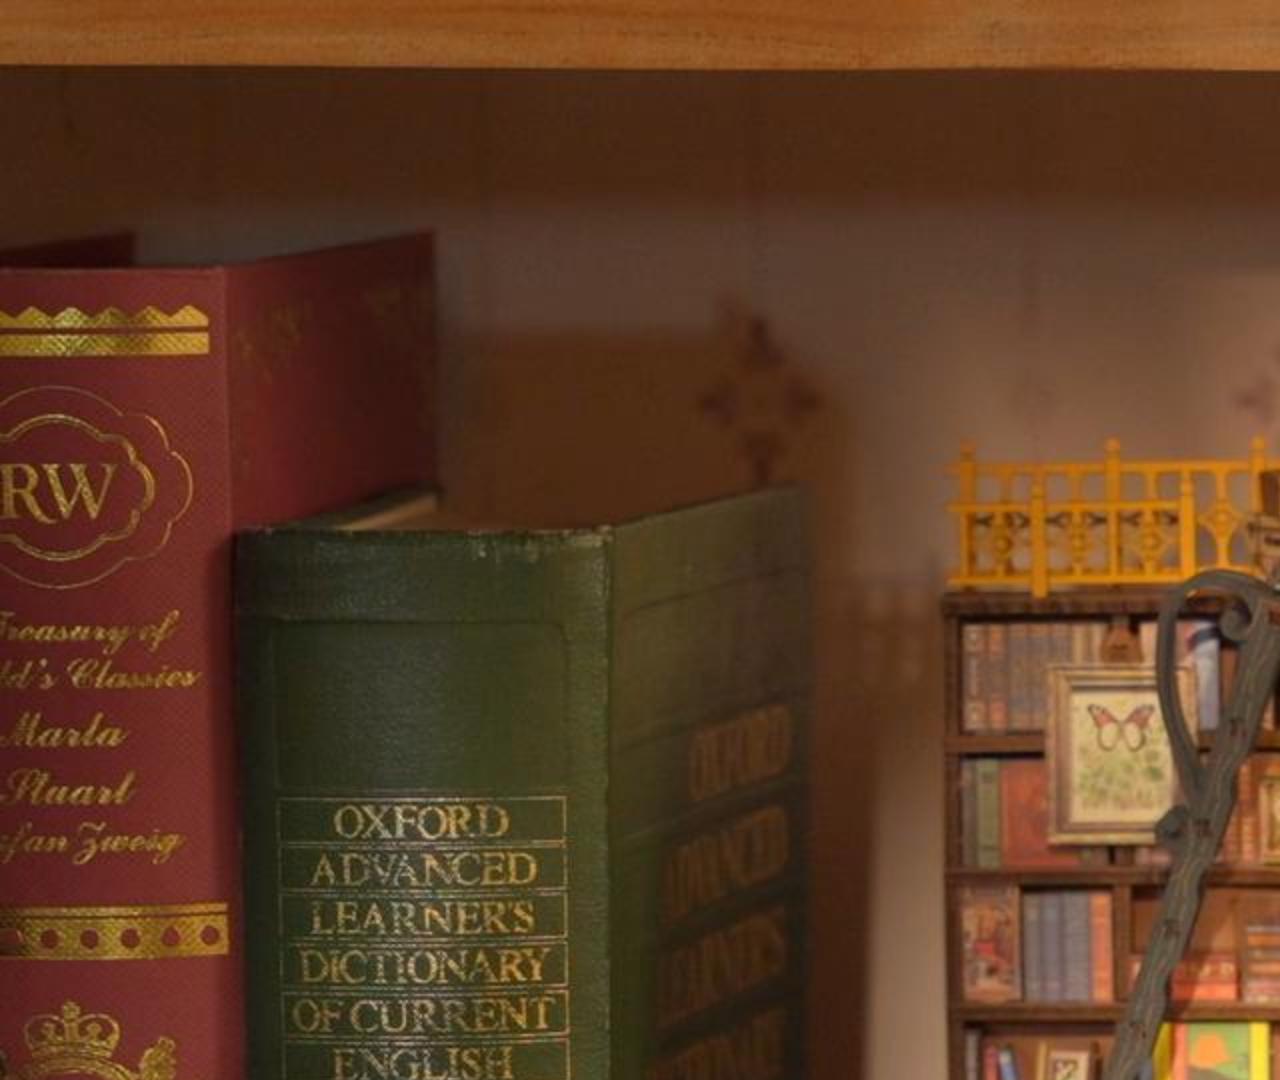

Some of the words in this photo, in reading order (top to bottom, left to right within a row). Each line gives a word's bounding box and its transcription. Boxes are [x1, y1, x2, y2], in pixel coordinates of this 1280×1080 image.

[139, 609, 181, 652] of
[67, 657, 201, 689] Classics
[333, 803, 511, 839] OXFORD
[73, 821, 185, 865] Zweig
[311, 850, 538, 887] ADVANCED
[300, 948, 549, 984] DICTIONARY
[292, 999, 343, 1033] OF
[350, 997, 556, 1033] CURRENT
